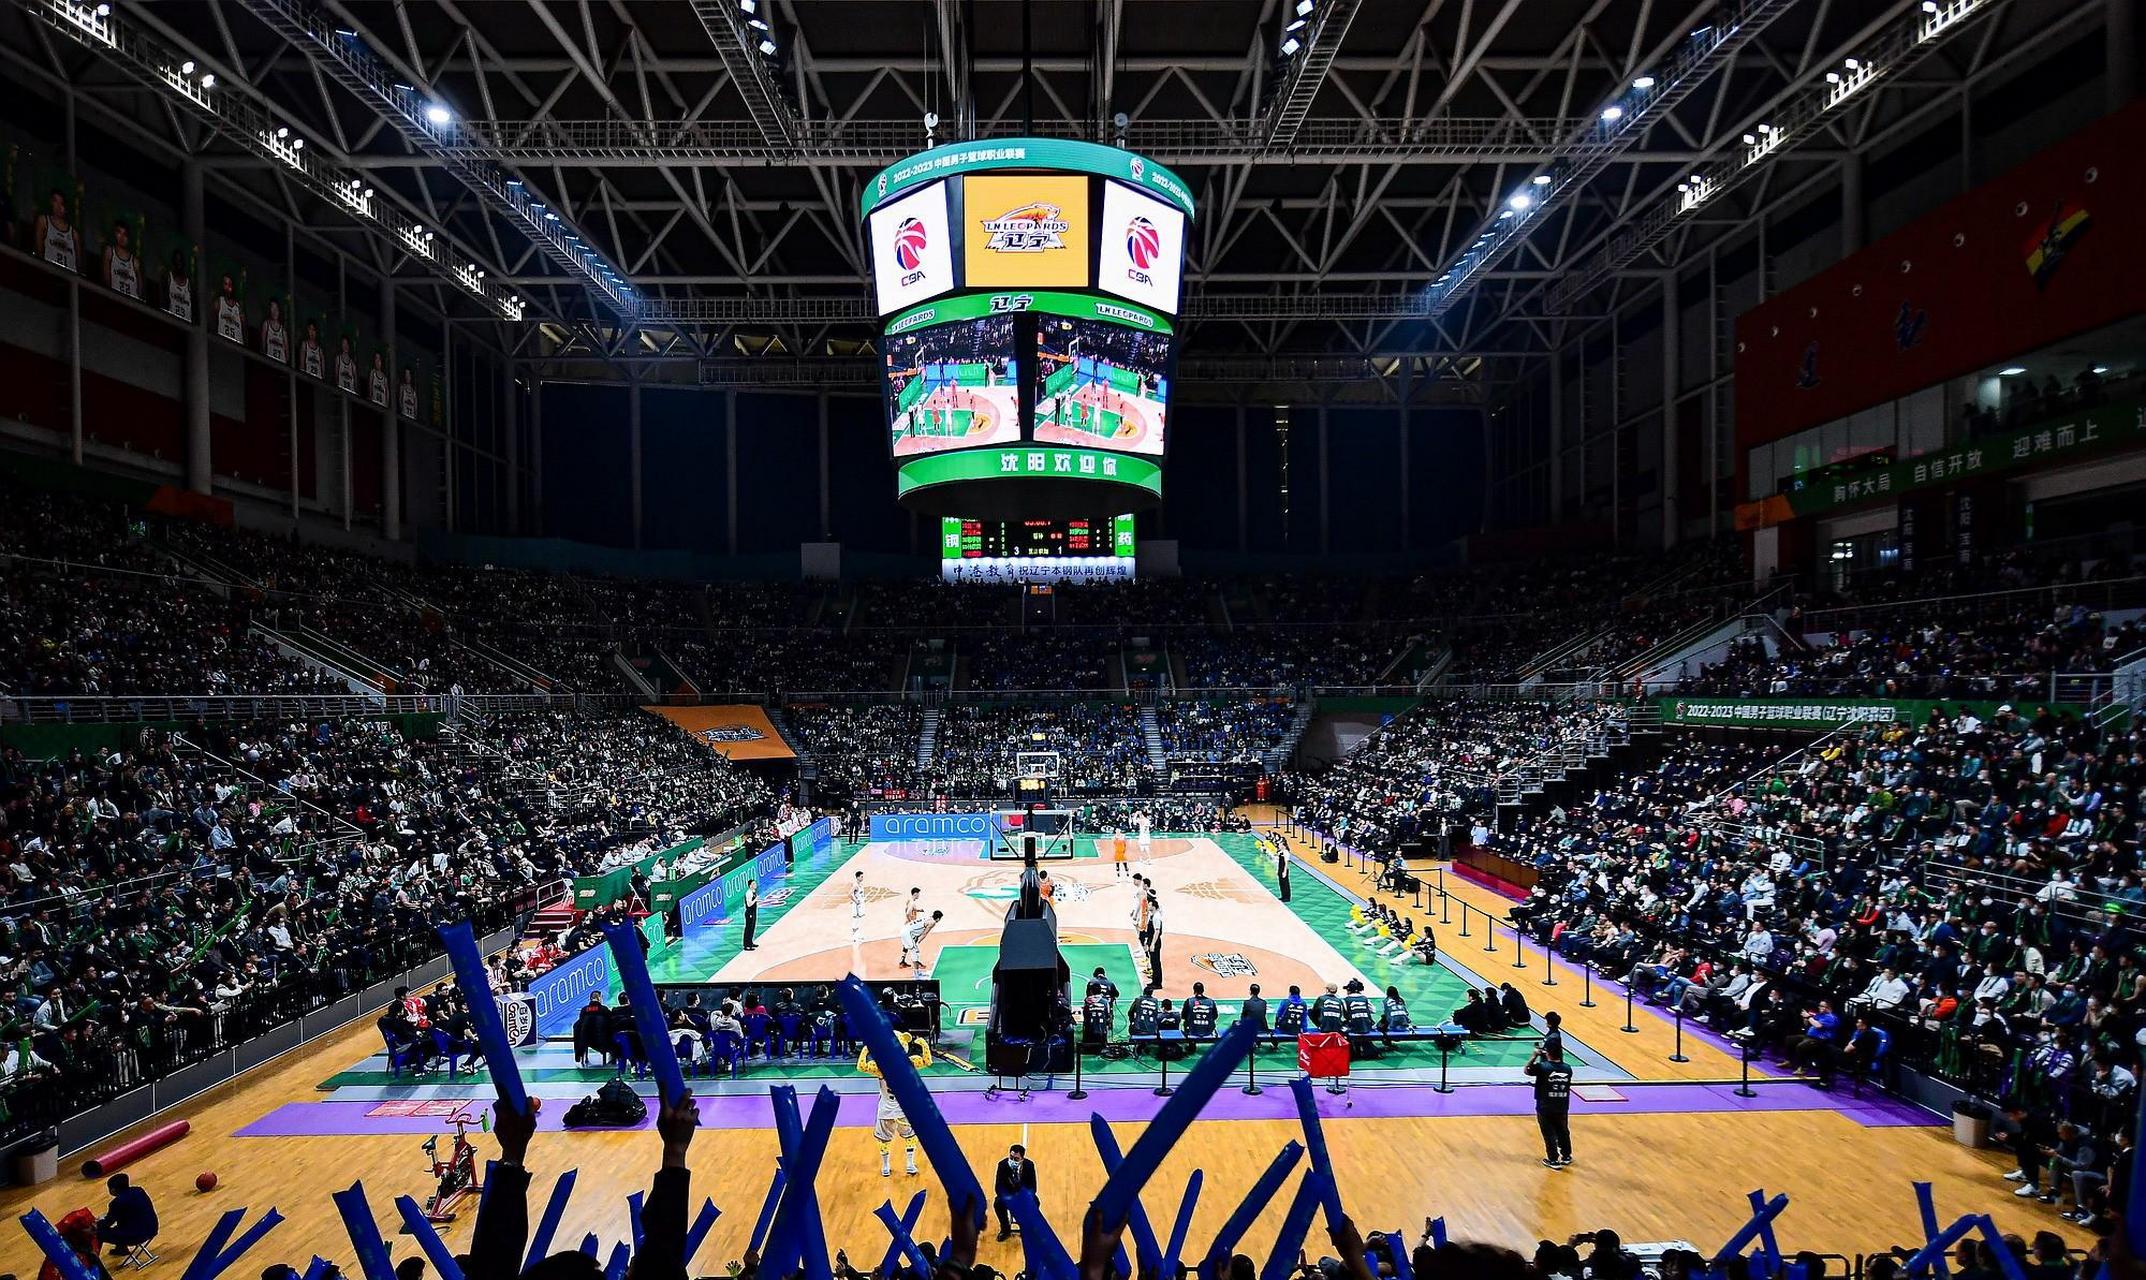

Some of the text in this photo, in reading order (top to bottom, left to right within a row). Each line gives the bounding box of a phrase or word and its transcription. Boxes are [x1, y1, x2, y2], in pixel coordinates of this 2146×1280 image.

[893, 161, 933, 184] 2022-2023
[1003, 220, 1066, 231] LEOPARDS
[901, 271, 926, 287] CBA
[1128, 269, 1153, 287] CBA
[1914, 448, 1983, 483] 自信开放
[2013, 417, 2100, 459] 迎难而上
[1687, 704, 1733, 719] 2022-2023
[885, 817, 986, 834] aramco
[758, 849, 785, 877] aramco
[725, 864, 756, 899] aramco
[684, 886, 723, 925] aramco
[536, 957, 605, 1018] aramco
